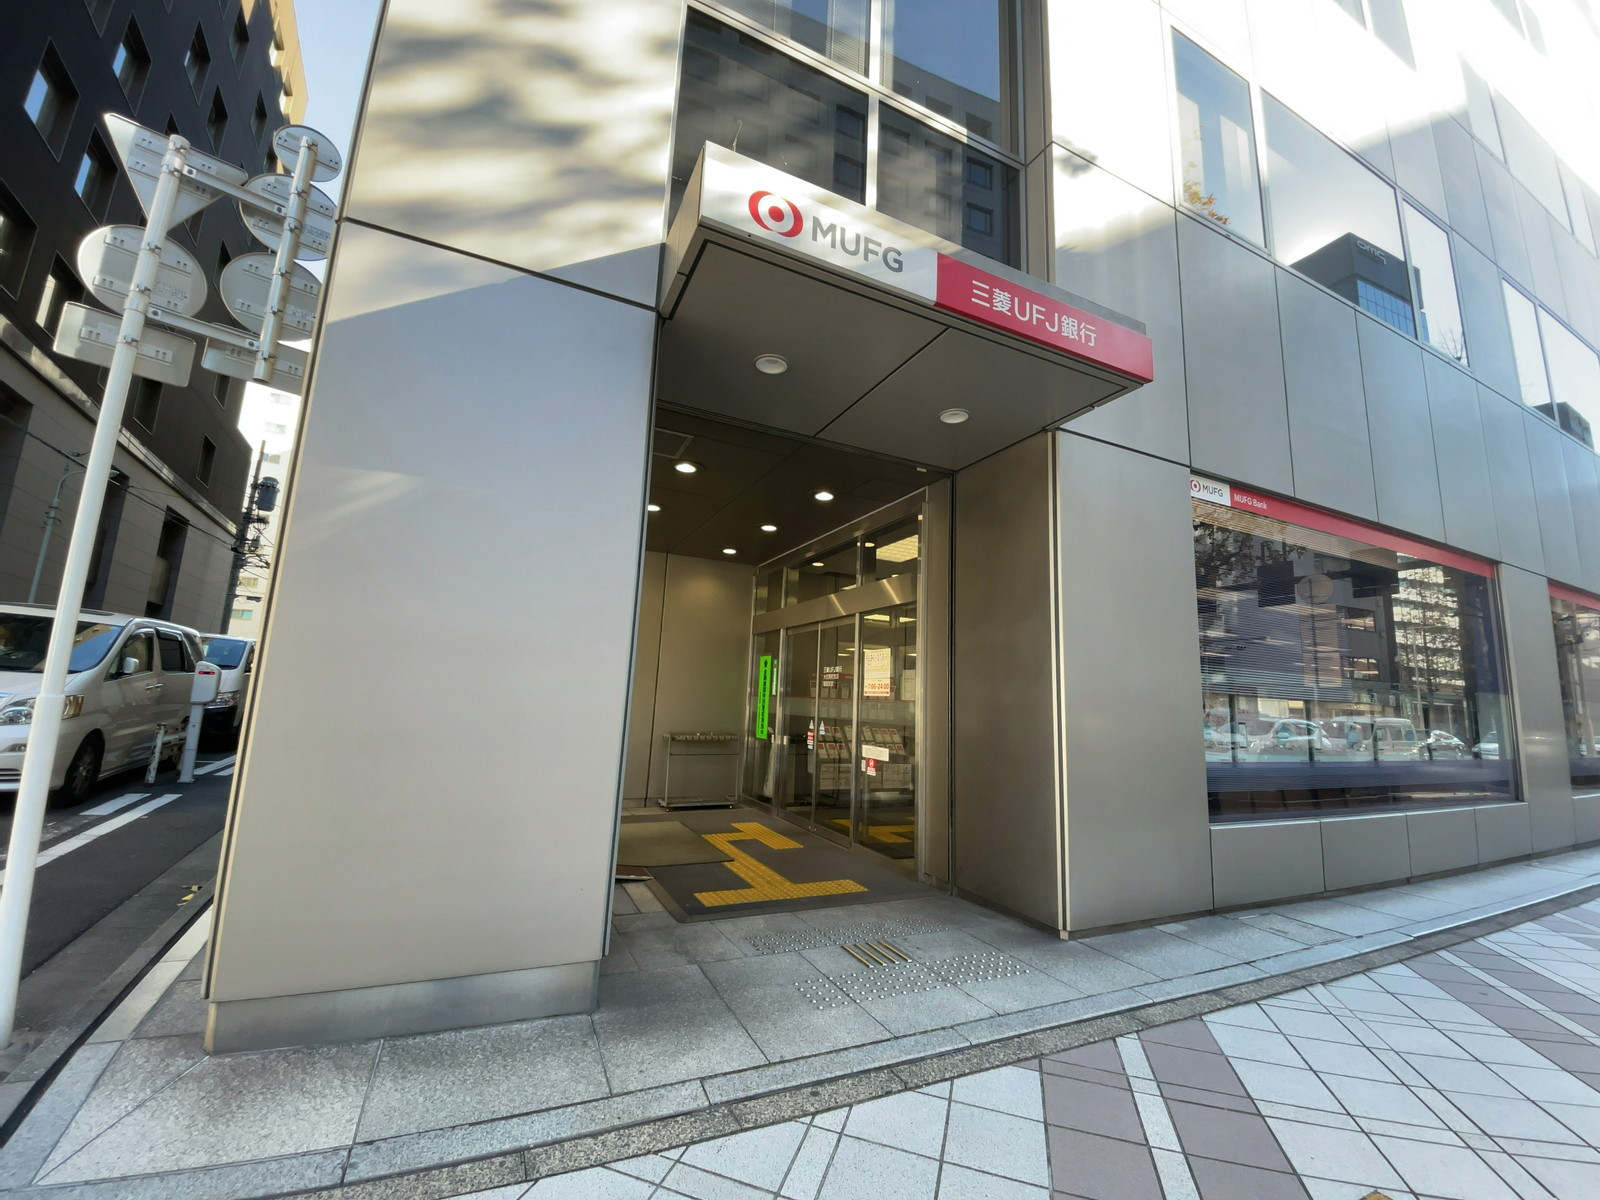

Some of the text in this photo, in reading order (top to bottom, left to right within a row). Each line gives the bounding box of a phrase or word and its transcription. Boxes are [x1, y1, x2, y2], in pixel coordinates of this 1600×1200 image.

[811, 215, 904, 273] MUFG
[971, 279, 1097, 347] 三菱UFJ銀行
[1202, 484, 1223, 497] MUFG
[1233, 493, 1267, 509] MUFG Bank
